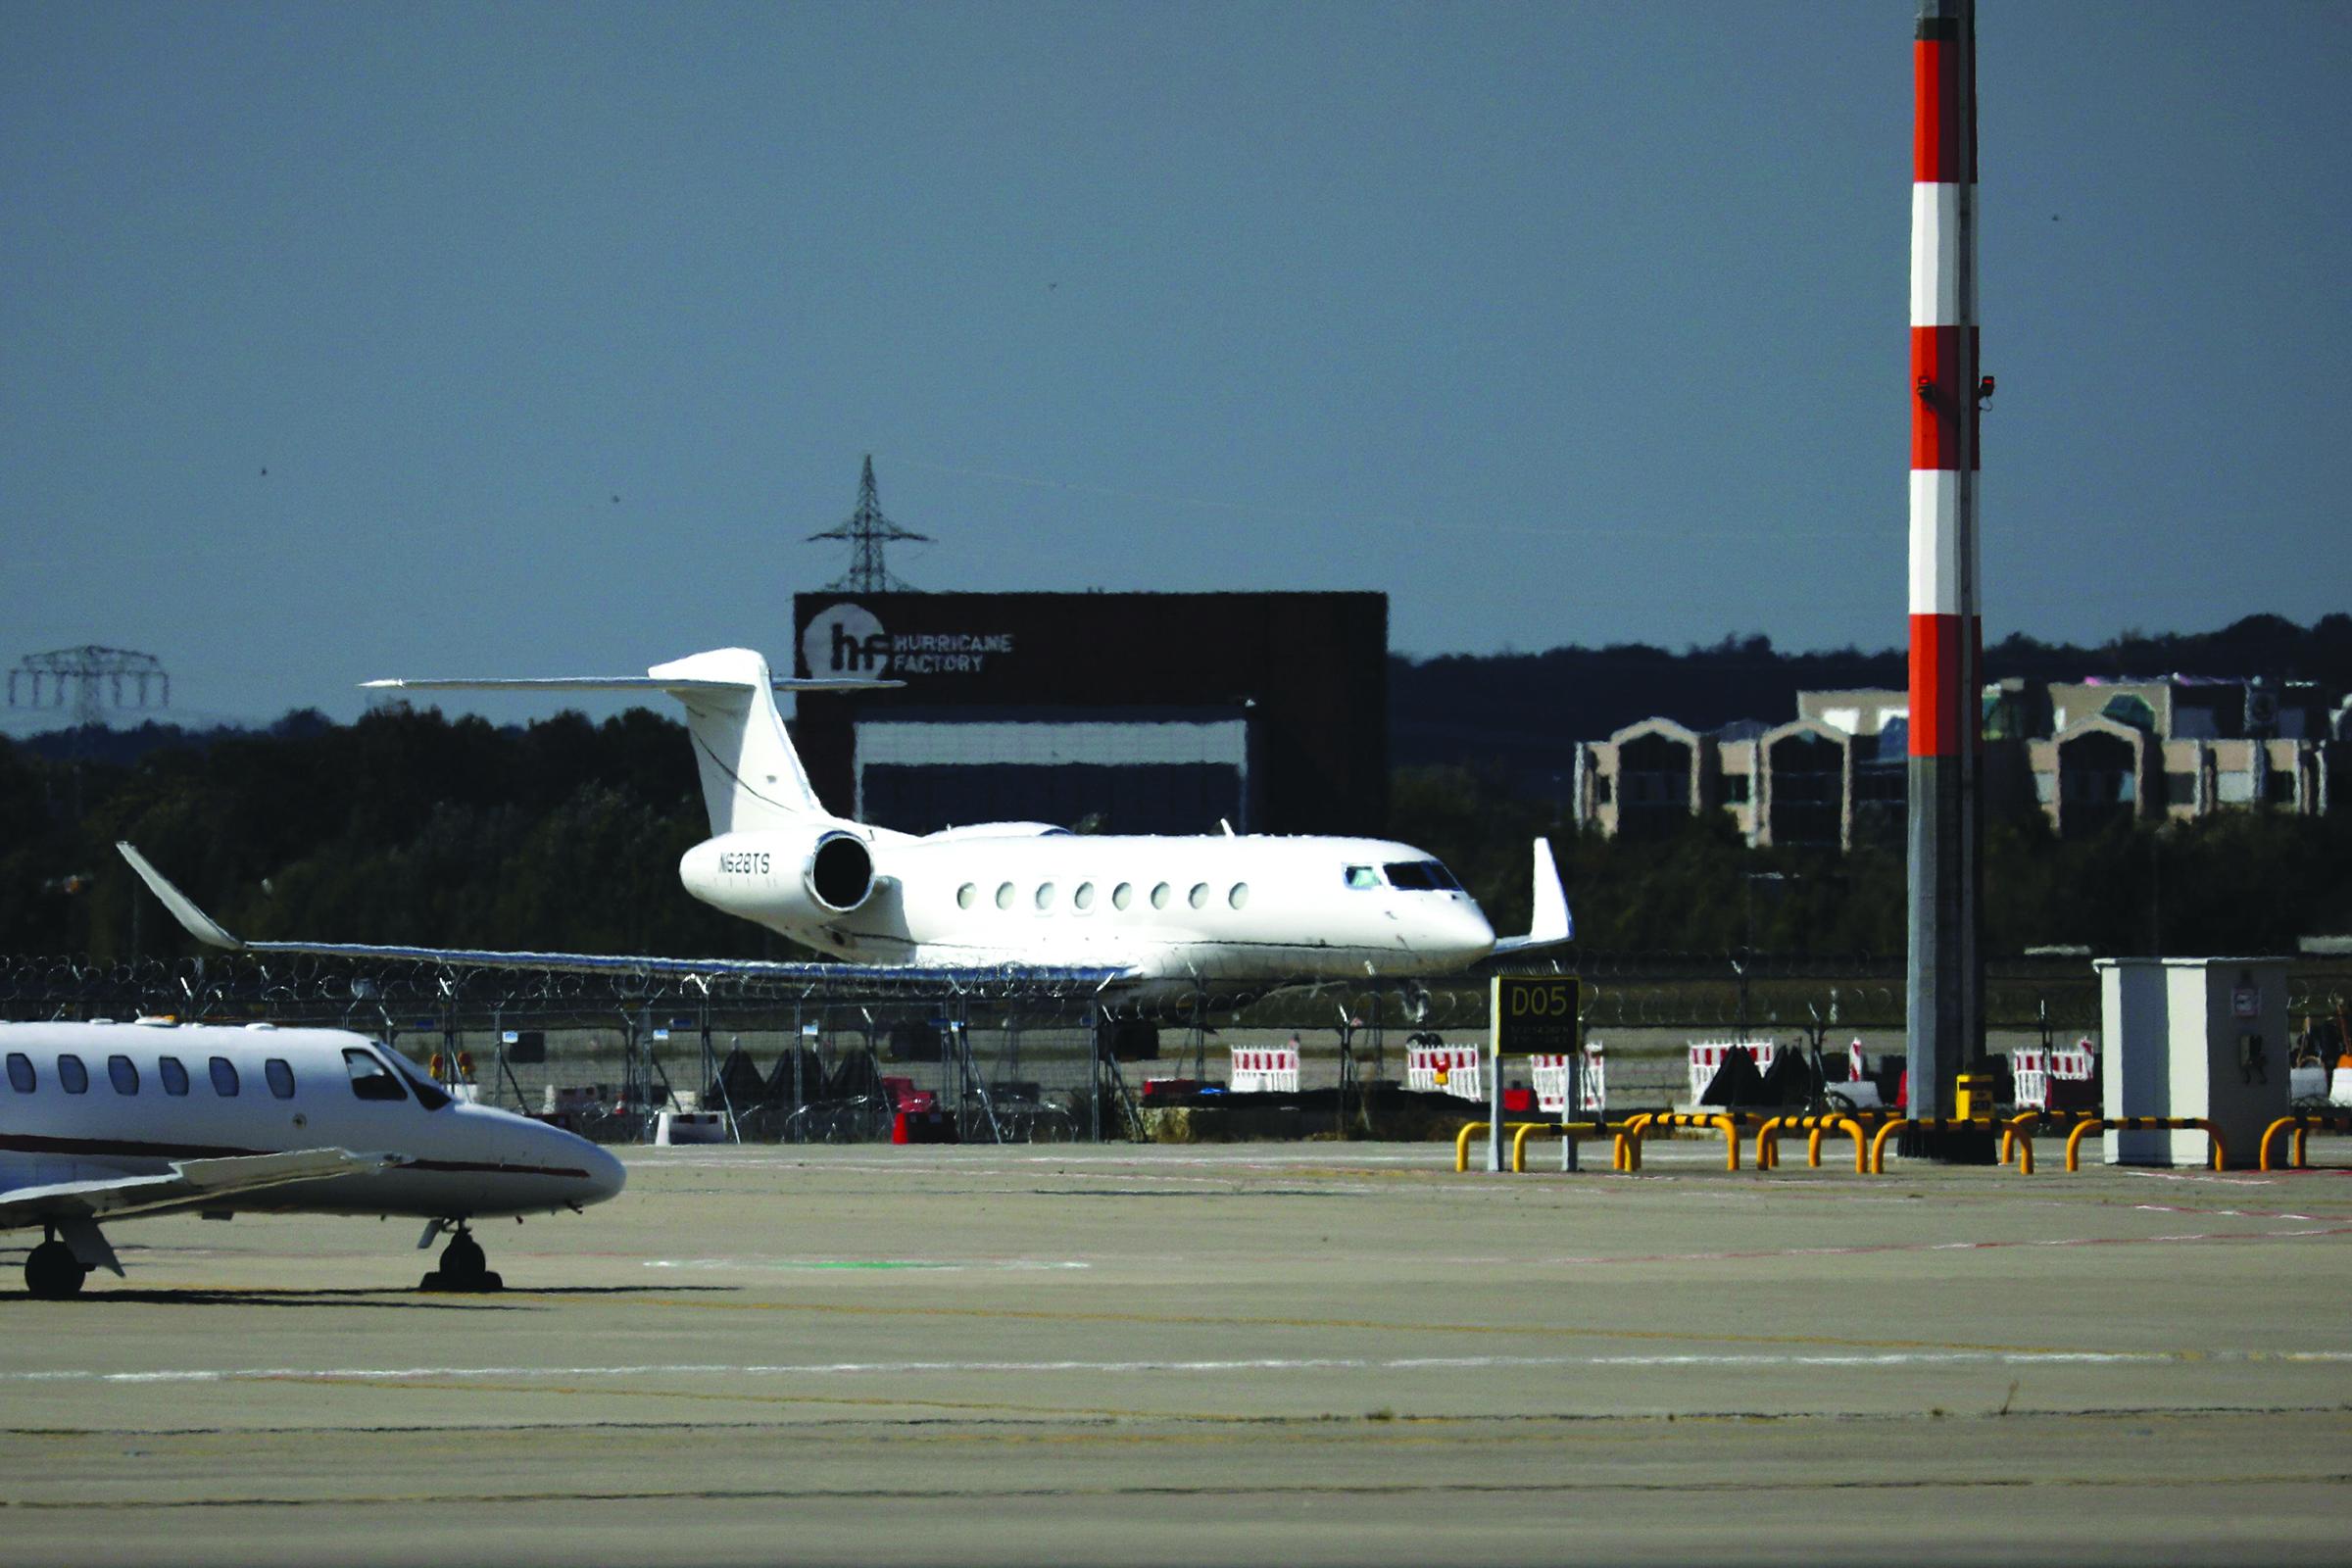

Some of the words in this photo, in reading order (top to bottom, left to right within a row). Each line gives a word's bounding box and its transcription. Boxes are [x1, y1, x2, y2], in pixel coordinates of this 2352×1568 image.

[893, 633, 1014, 653] HURRICANE
[893, 654, 983, 673] FACTORY
[719, 853, 770, 875] N628TS
[1512, 986, 1568, 1016] D05
